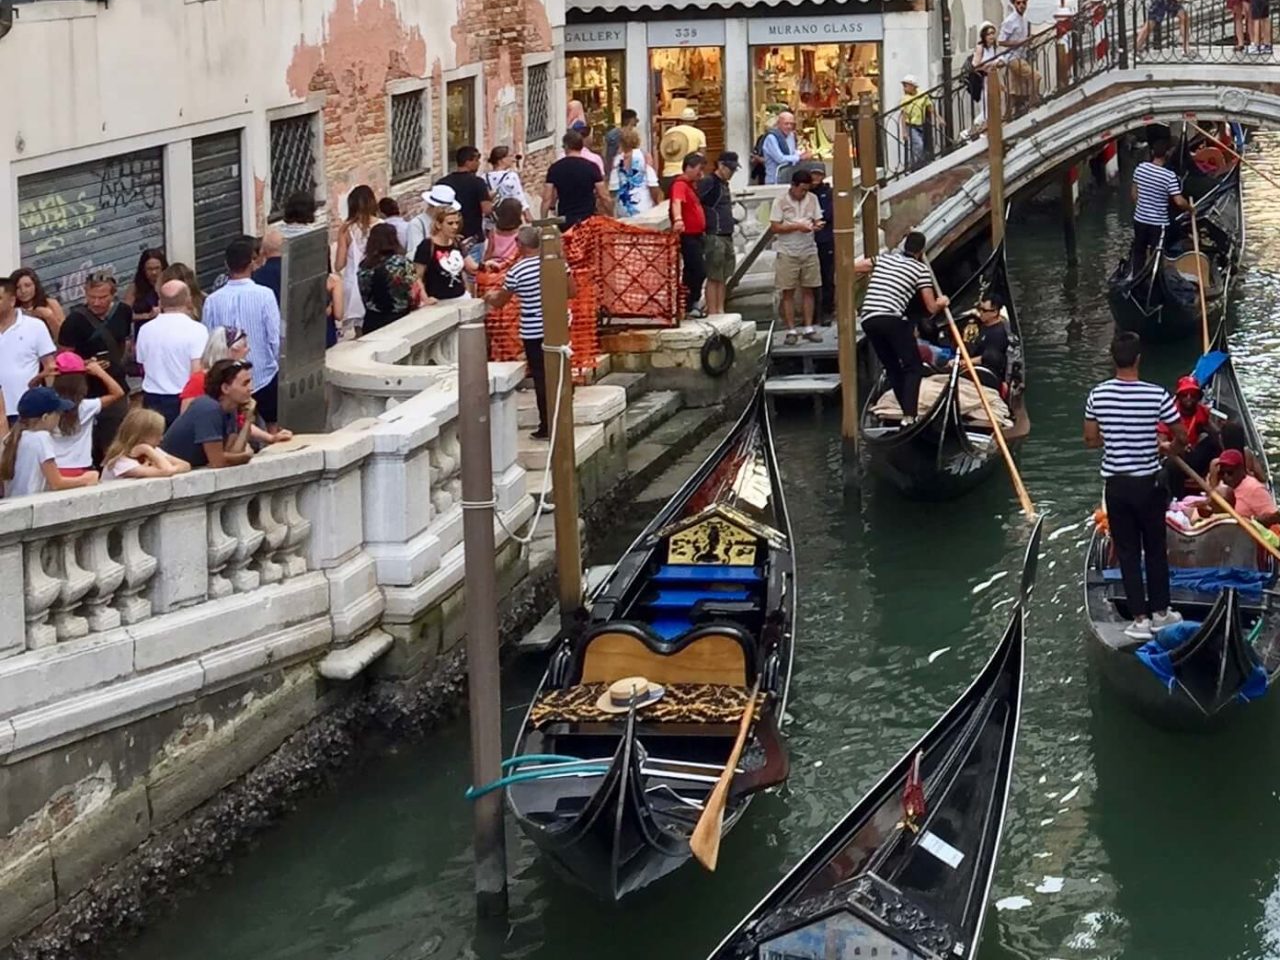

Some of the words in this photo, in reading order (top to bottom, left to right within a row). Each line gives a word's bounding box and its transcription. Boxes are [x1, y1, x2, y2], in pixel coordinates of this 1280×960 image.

[769, 23, 818, 35] MURANO
[823, 22, 863, 34] GLASS
[565, 31, 622, 43] GALLERY
